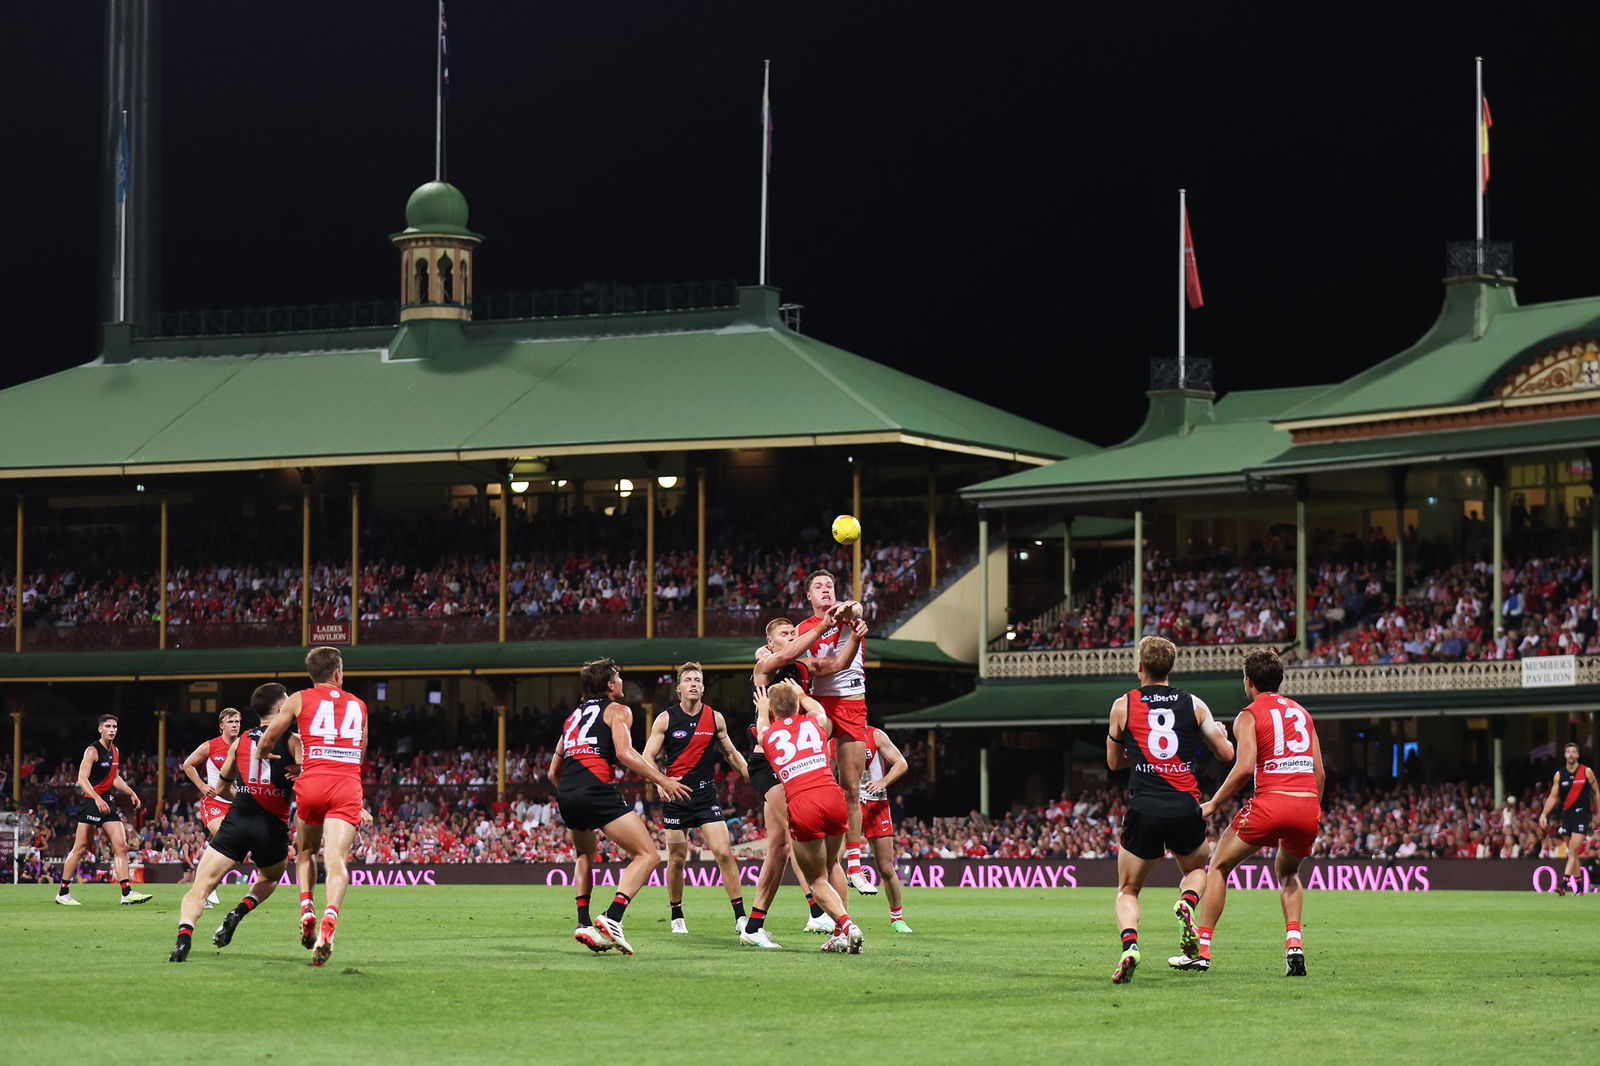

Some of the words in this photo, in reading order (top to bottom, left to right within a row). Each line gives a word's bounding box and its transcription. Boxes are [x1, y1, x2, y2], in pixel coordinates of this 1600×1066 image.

[313, 632, 346, 641] PAVILION
[316, 625, 343, 633] LADIES
[1525, 659, 1572, 670] MEMBERS
[1526, 672, 1571, 683] PAVILION
[1149, 694, 1178, 703] Liberty
[309, 699, 364, 747] 44
[563, 704, 600, 751] 22
[1147, 707, 1179, 760] 8
[1269, 707, 1310, 756] 13
[767, 720, 823, 766] 34
[1135, 761, 1192, 773] AIRSTAGE
[959, 865, 1077, 888] AIRWAYS
[1307, 865, 1430, 892] AIRWAYS
